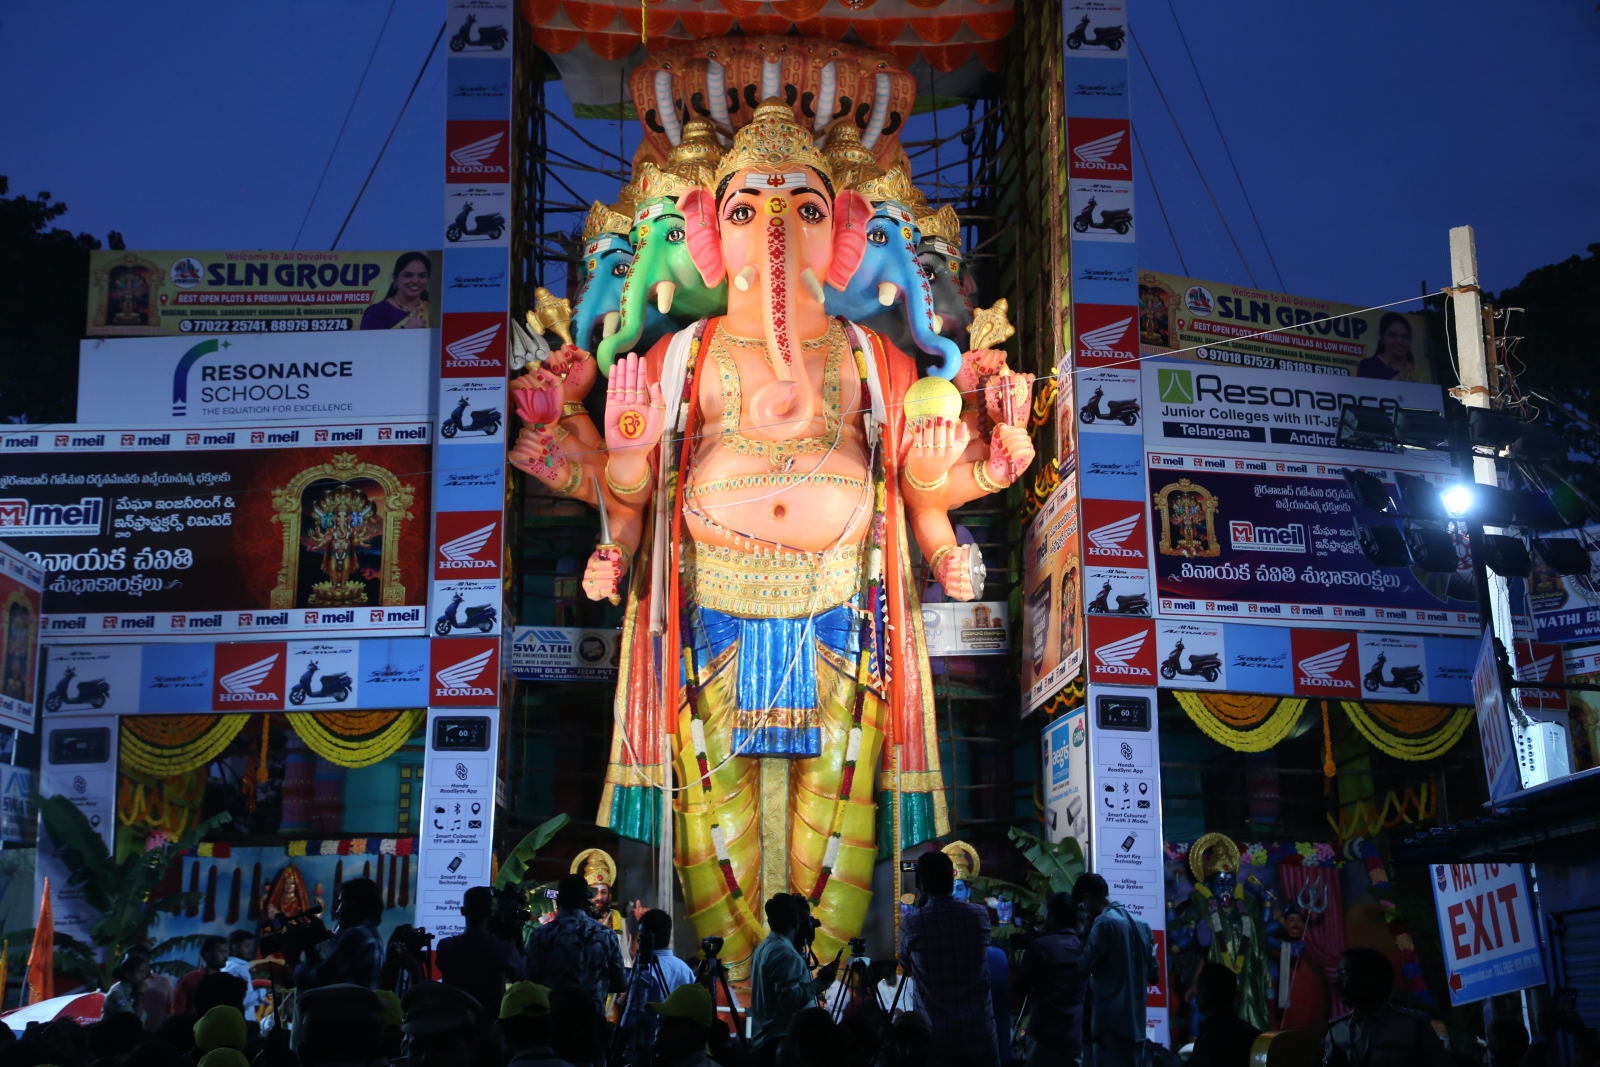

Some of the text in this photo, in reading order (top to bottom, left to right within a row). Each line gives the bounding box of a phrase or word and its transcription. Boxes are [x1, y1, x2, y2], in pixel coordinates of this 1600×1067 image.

[449, 166, 505, 174] HONDA
[1074, 161, 1129, 171] HONDA
[207, 263, 381, 290] SLN GROUP
[1217, 295, 1370, 340] SLN GROUP
[193, 321, 229, 332] 77022
[270, 320, 309, 331] 88979
[311, 319, 348, 330] 93274
[1080, 349, 1136, 359] HONDA
[1209, 349, 1242, 365] 97018
[446, 359, 502, 368] HONDA
[201, 361, 353, 381] RESONANCE
[201, 383, 310, 403] SCHOOLS
[202, 403, 353, 416] THE EQUATION FOR EXCELLENCE
[1162, 405, 1340, 428] Junior Colleges with IIT-JE
[203, 432, 235, 444] meil
[267, 431, 299, 443] meil
[331, 429, 362, 441] meil
[394, 427, 426, 439] meil
[1180, 424, 1251, 440] Telangana
[5, 435, 38, 447] meil
[72, 435, 105, 447] meil
[138, 434, 170, 446] meil
[1289, 432, 1338, 447] Andhra
[1163, 456, 1184, 466] meil
[1204, 459, 1226, 469] meil
[1246, 461, 1267, 471] meil
[1287, 463, 1308, 473] meil
[33, 500, 100, 525] meil
[1257, 525, 1304, 545] meil
[133, 546, 194, 571] చవితి
[1088, 547, 1145, 558] HONDA
[439, 560, 497, 569] HONDA
[1180, 562, 1251, 580] వినాయక
[1255, 563, 1297, 584] చవితి
[1174, 600, 1196, 610] meil
[1216, 602, 1239, 613] meil
[1259, 604, 1281, 614] meil
[1301, 606, 1323, 616] meil
[322, 611, 354, 624] meil
[387, 609, 419, 622] meil
[1344, 607, 1366, 618] meil
[1386, 609, 1407, 620] meil
[1427, 611, 1448, 622] meil
[52, 617, 86, 629] meil
[121, 616, 155, 628] meil
[189, 615, 222, 627] meil
[256, 613, 288, 626] meil
[513, 644, 572, 653] SWATHI
[1095, 664, 1152, 676] HONDA
[1299, 677, 1355, 688] HONDA
[219, 692, 280, 702] HONDA
[436, 688, 495, 697] HONDA
[1519, 688, 1560, 699] ONDA
[1448, 883, 1520, 960] EXIT
